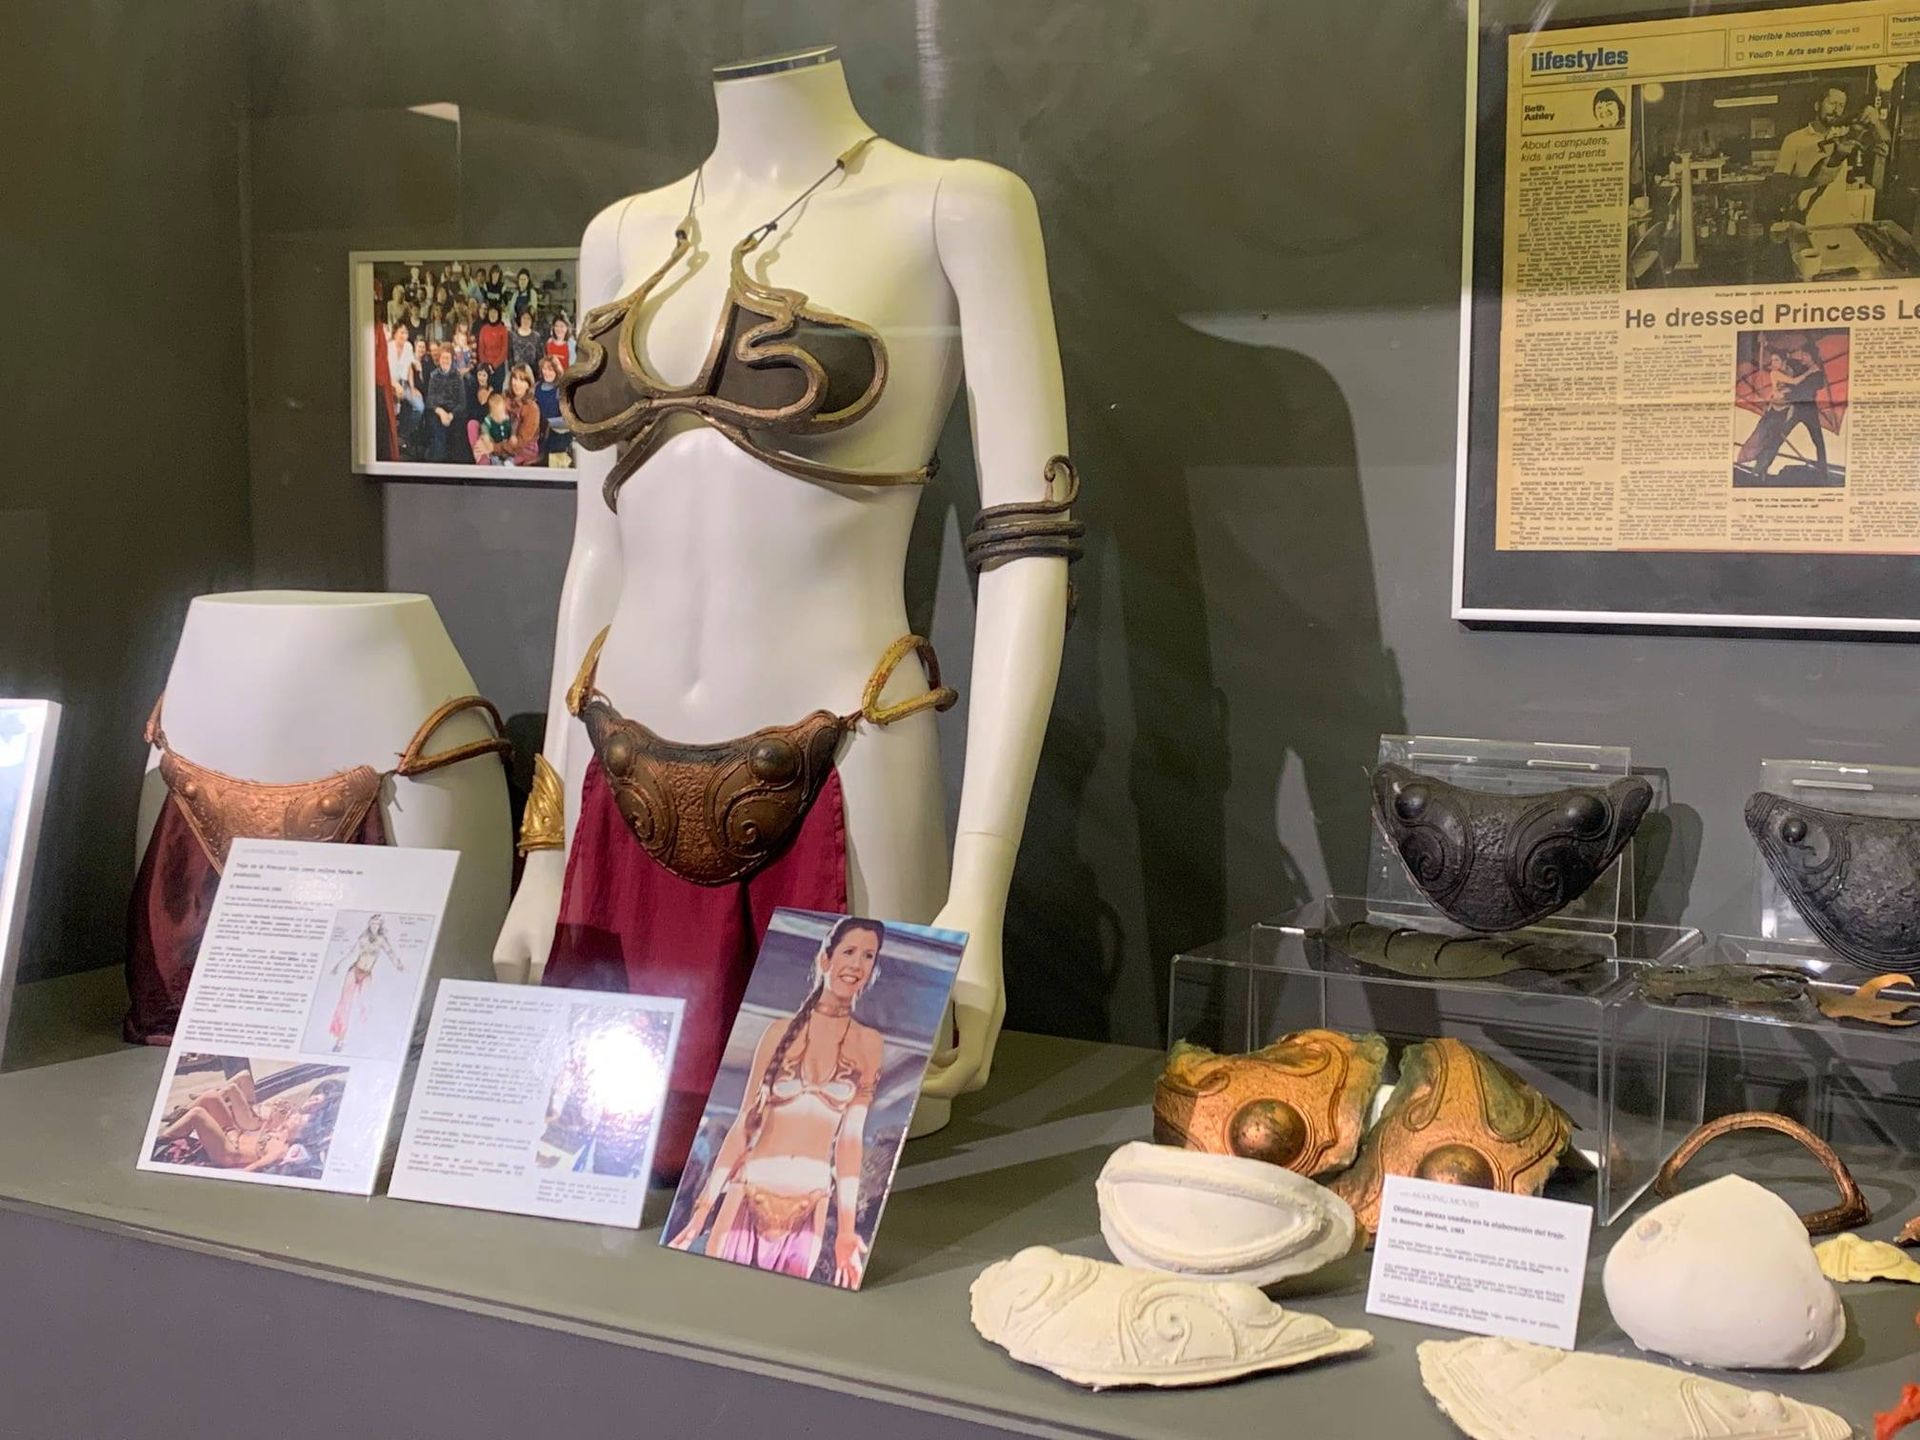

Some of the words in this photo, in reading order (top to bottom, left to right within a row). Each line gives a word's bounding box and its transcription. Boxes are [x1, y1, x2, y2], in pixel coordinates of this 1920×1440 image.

[1748, 29, 1783, 42] Horrible
[1531, 48, 1629, 72] lifestyles
[1748, 50, 1773, 60] Youth
[1786, 46, 1806, 56] Arts
[1524, 104, 1545, 112] Beth
[1524, 112, 1555, 120] Ashley
[1521, 140, 1551, 150] About
[1521, 152, 1541, 162] kids
[1546, 150, 1565, 160] and
[1568, 148, 1606, 161] parents
[1626, 308, 1656, 329] He
[1665, 304, 1764, 327] dressed
[1775, 302, 1886, 324] Princess
[1393, 1204, 1423, 1216] Distintas
[1424, 1210, 1446, 1220] piezas
[1448, 1214, 1472, 1225] usadas
[1483, 1218, 1490, 1227] la
[1492, 1220, 1533, 1236] elaboración
[1534, 1226, 1546, 1238] del
